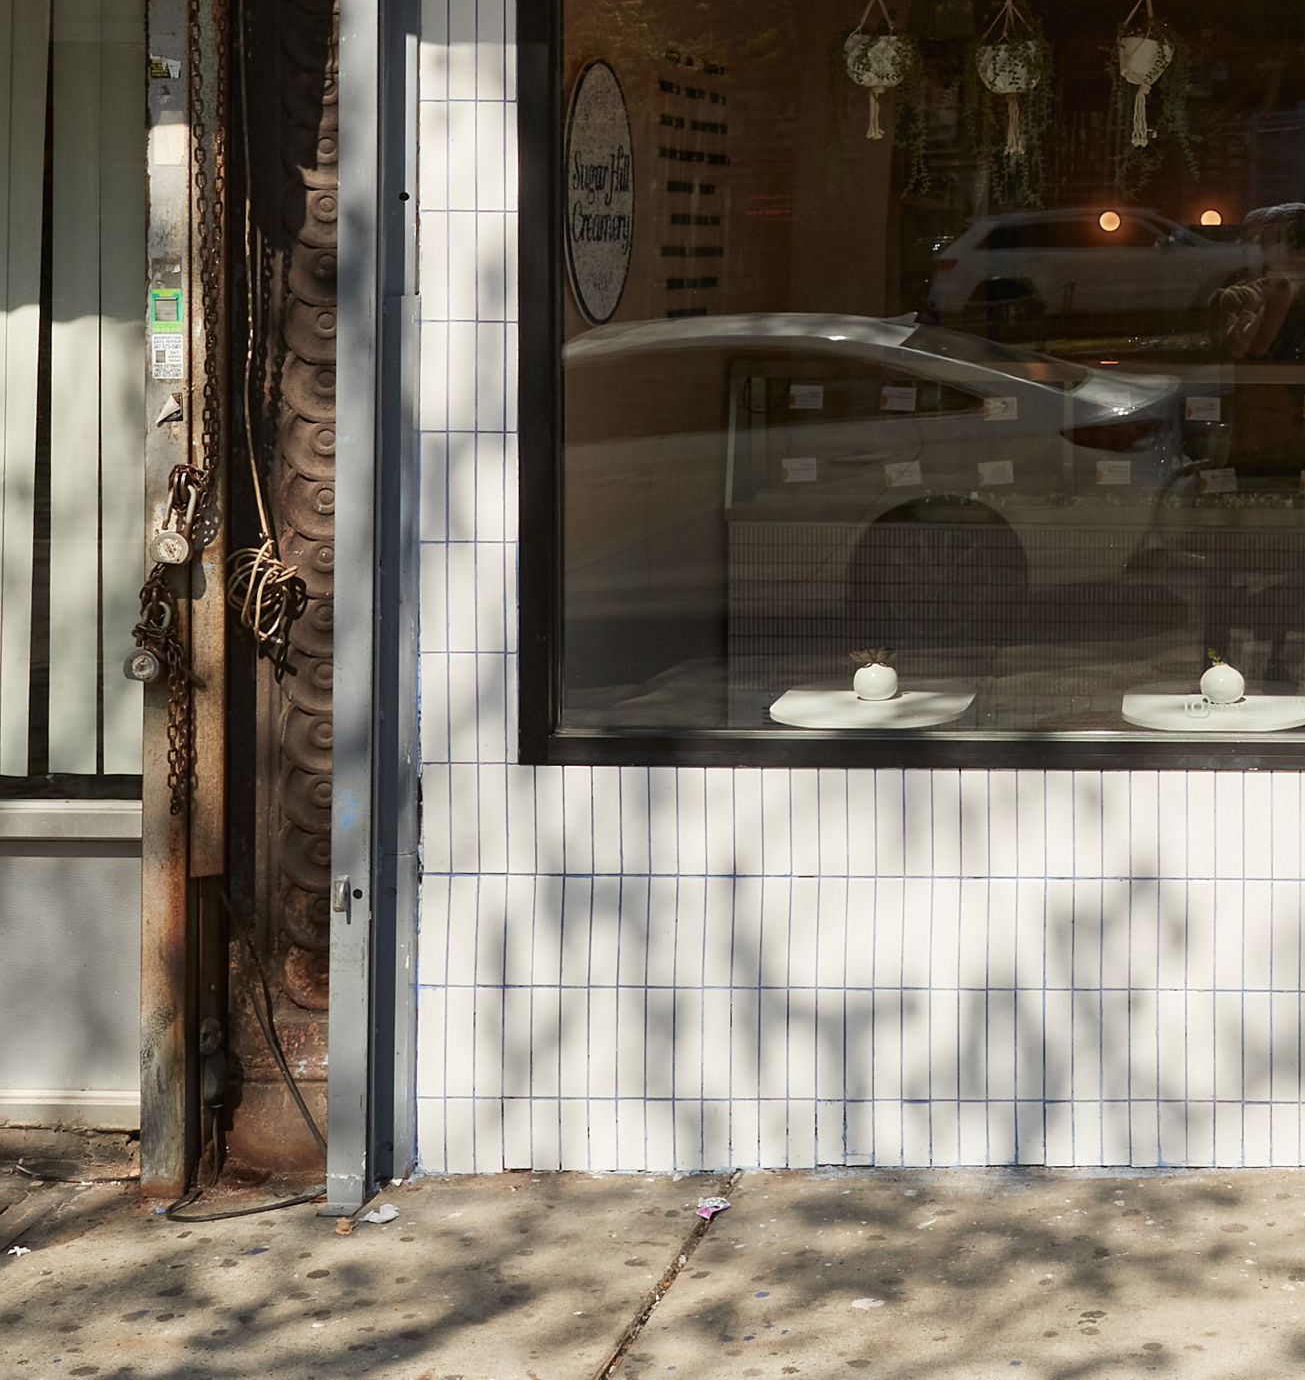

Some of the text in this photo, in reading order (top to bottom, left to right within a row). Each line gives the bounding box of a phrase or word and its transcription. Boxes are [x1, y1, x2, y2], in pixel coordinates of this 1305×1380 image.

[572, 144, 631, 206] Sugar Hill
[572, 200, 631, 256] Creamery
